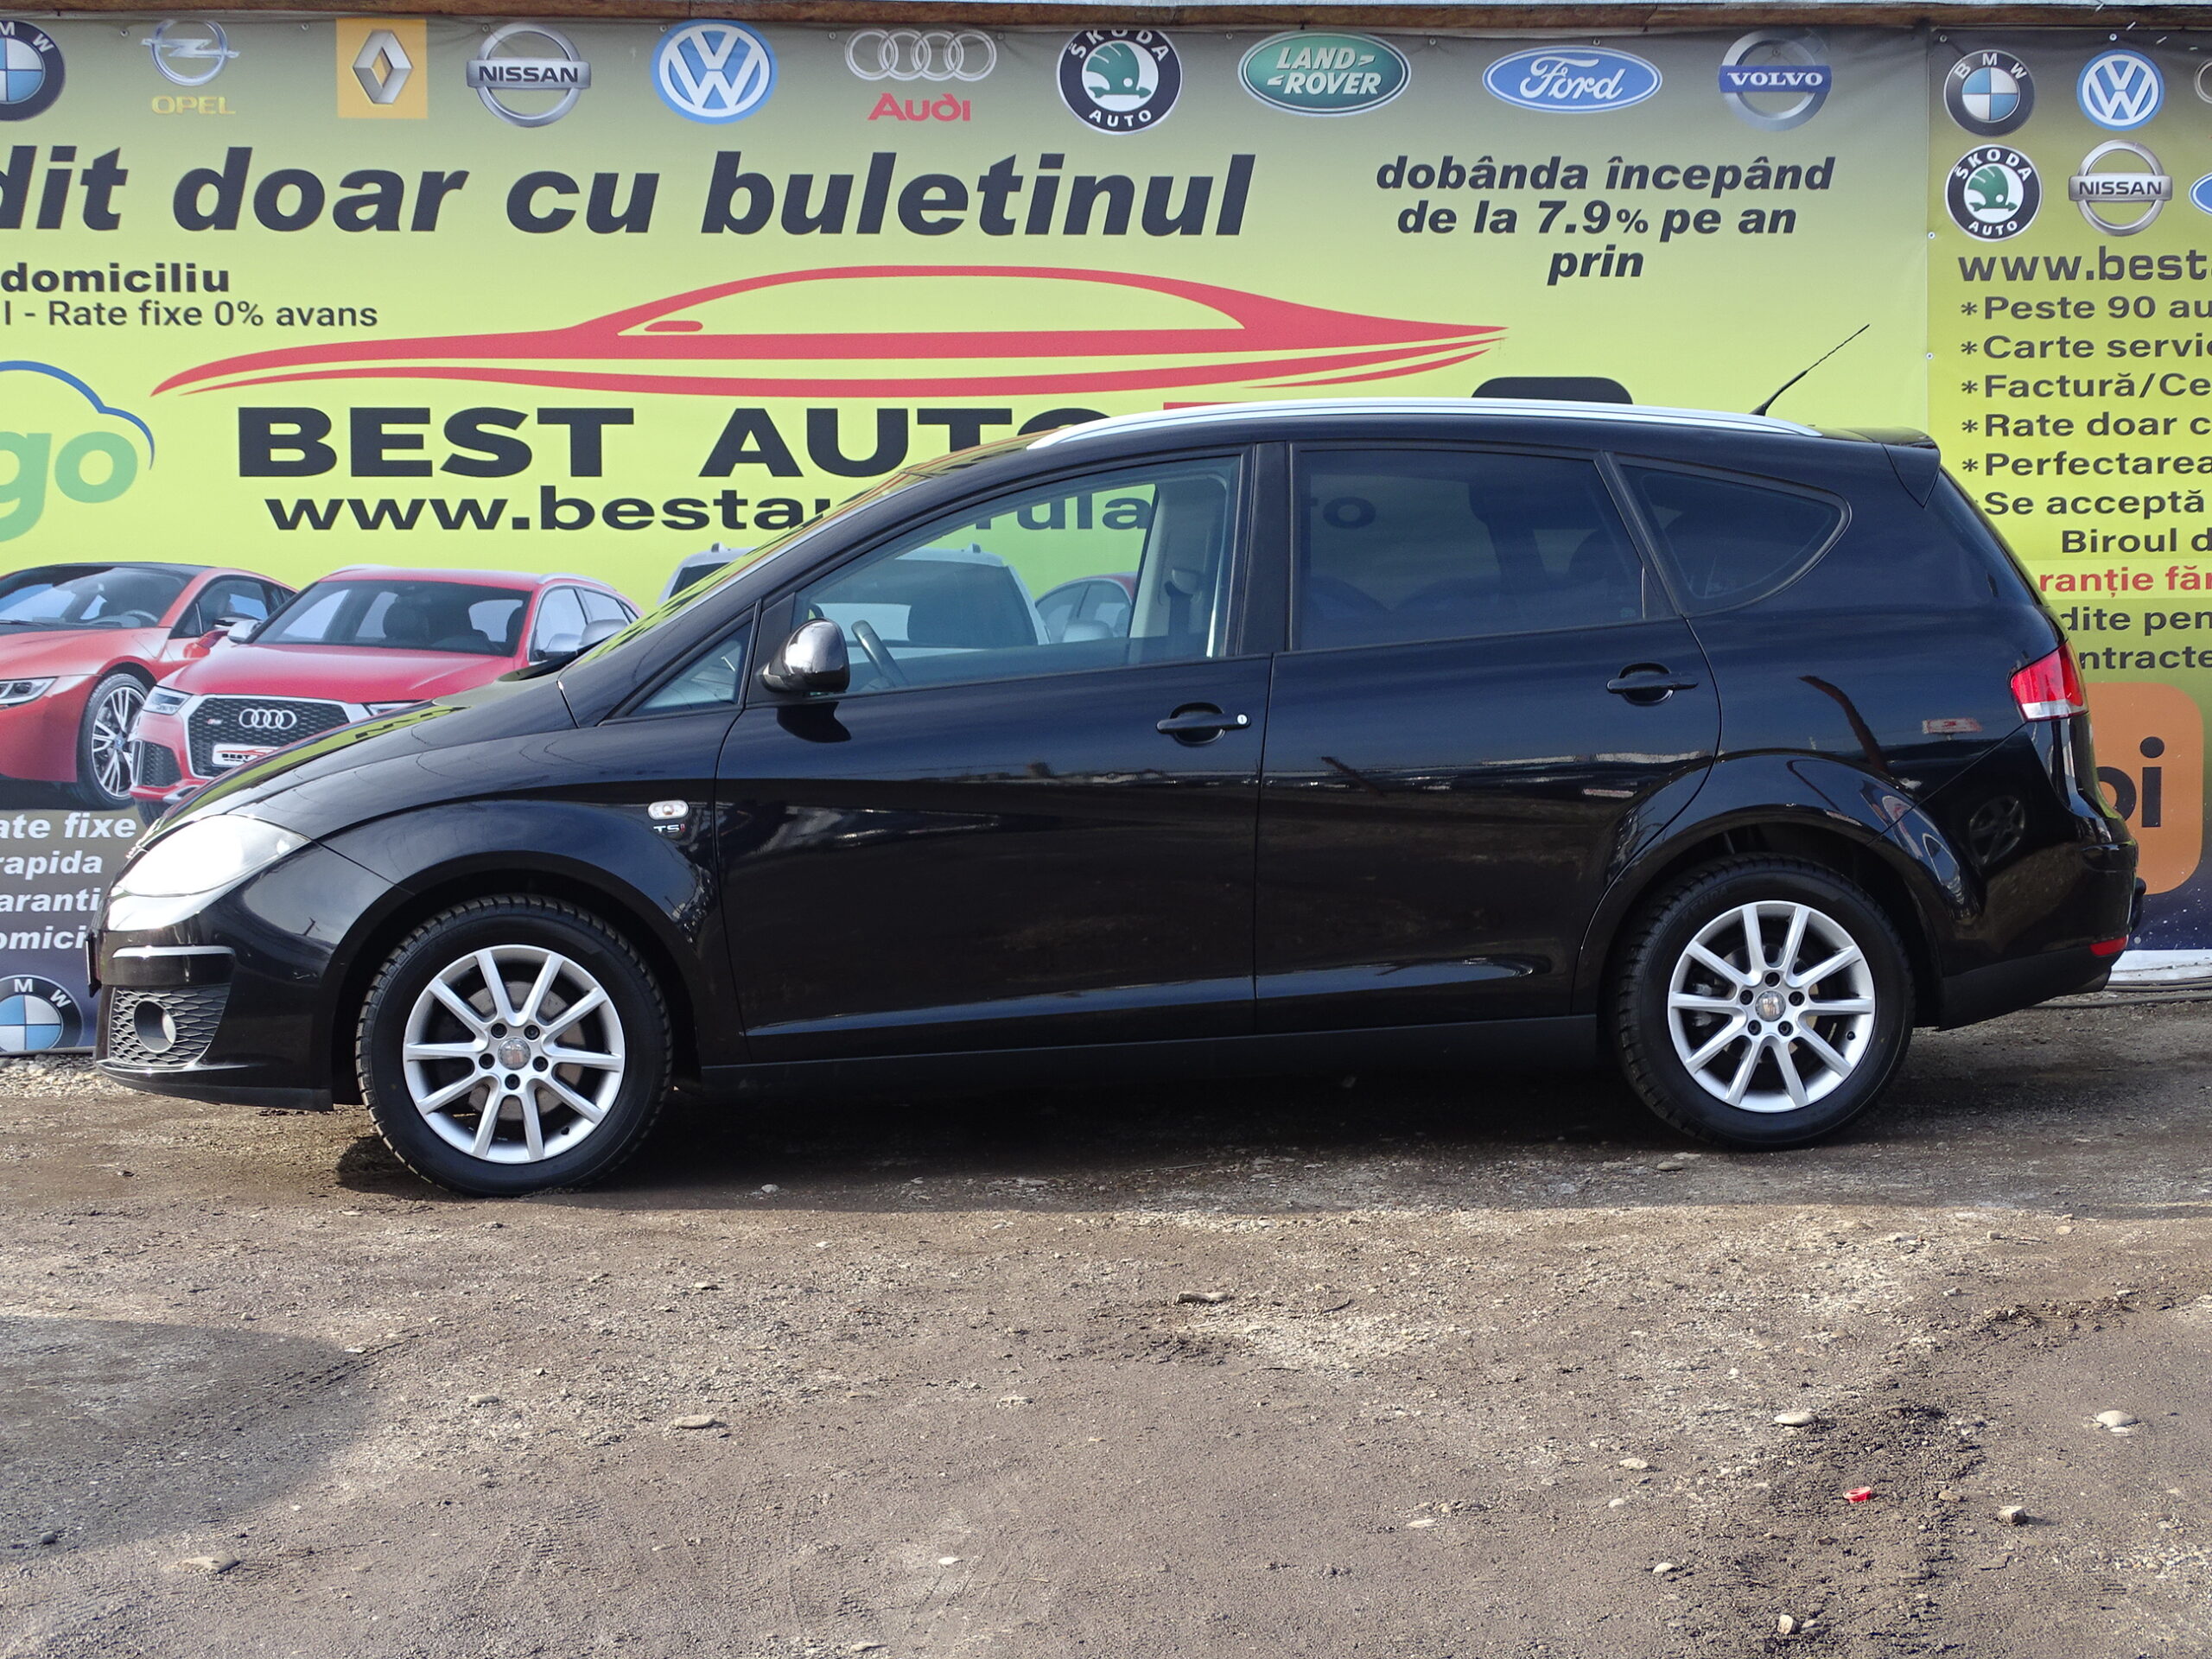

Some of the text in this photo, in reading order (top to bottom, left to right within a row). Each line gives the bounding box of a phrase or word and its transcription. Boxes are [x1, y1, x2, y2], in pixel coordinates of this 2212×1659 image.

[1276, 47, 1358, 70] LAND
[1955, 53, 2027, 79] BMW
[479, 65, 579, 84] NISSAN
[1285, 72, 1382, 96] ROVER
[1519, 55, 1626, 101] Ford
[1726, 71, 1824, 86] VOLVO
[151, 96, 236, 115] OPEL
[868, 92, 971, 122] Audi
[1089, 110, 1152, 127] AUTO
[1376, 156, 1836, 199] dobânda începând
[2079, 181, 2162, 196] NISSAN
[173, 146, 469, 232] doar
[505, 169, 659, 234] cu
[701, 150, 1256, 236] buletinul
[1397, 200, 1458, 234] de
[1473, 200, 1518, 234] la
[1659, 207, 1722, 244] pe
[1738, 207, 1797, 234] an
[1968, 220, 2018, 236] AUTO
[1547, 244, 1645, 287] prin
[1958, 245, 2212, 282] www.best
[0, 262, 230, 293] domiciliu
[49, 301, 128, 327] Rate
[138, 299, 203, 327] fixe
[215, 301, 264, 327] 0%
[276, 306, 378, 327] avans
[2108, 295, 2157, 319] 90
[2107, 332, 2212, 358] servi
[2086, 411, 2177, 436] doar
[238, 407, 634, 478] BEST
[1984, 489, 2204, 519] Se acceptă
[2062, 528, 2177, 554] Biroul
[64, 812, 137, 838] fixe
